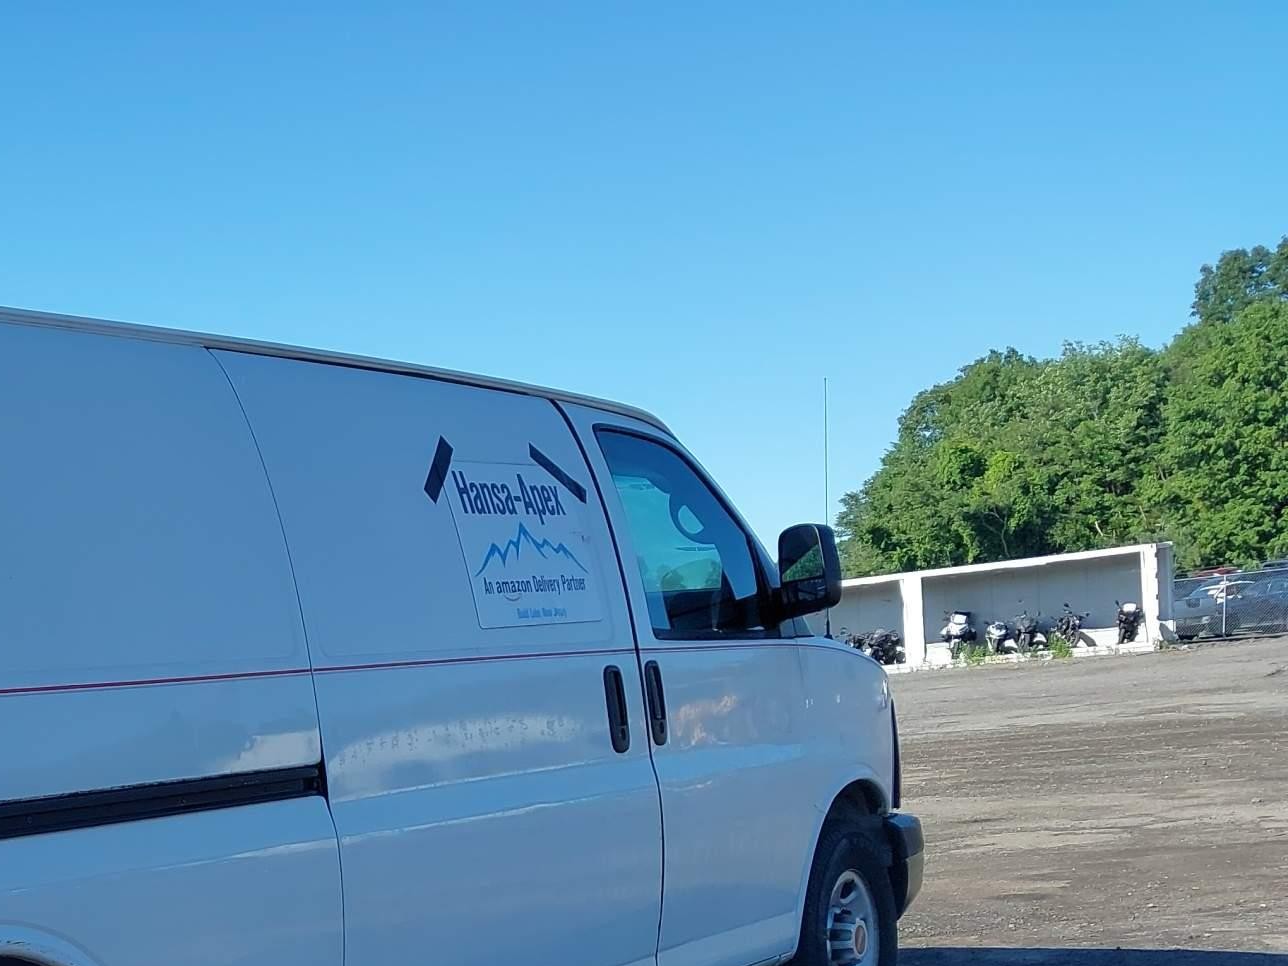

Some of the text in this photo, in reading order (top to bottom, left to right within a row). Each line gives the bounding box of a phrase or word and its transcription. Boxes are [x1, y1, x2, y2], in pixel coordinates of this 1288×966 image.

[452, 470, 566, 525] Hansa-Apex
[483, 574, 586, 596] An amazon Delivery Partner
